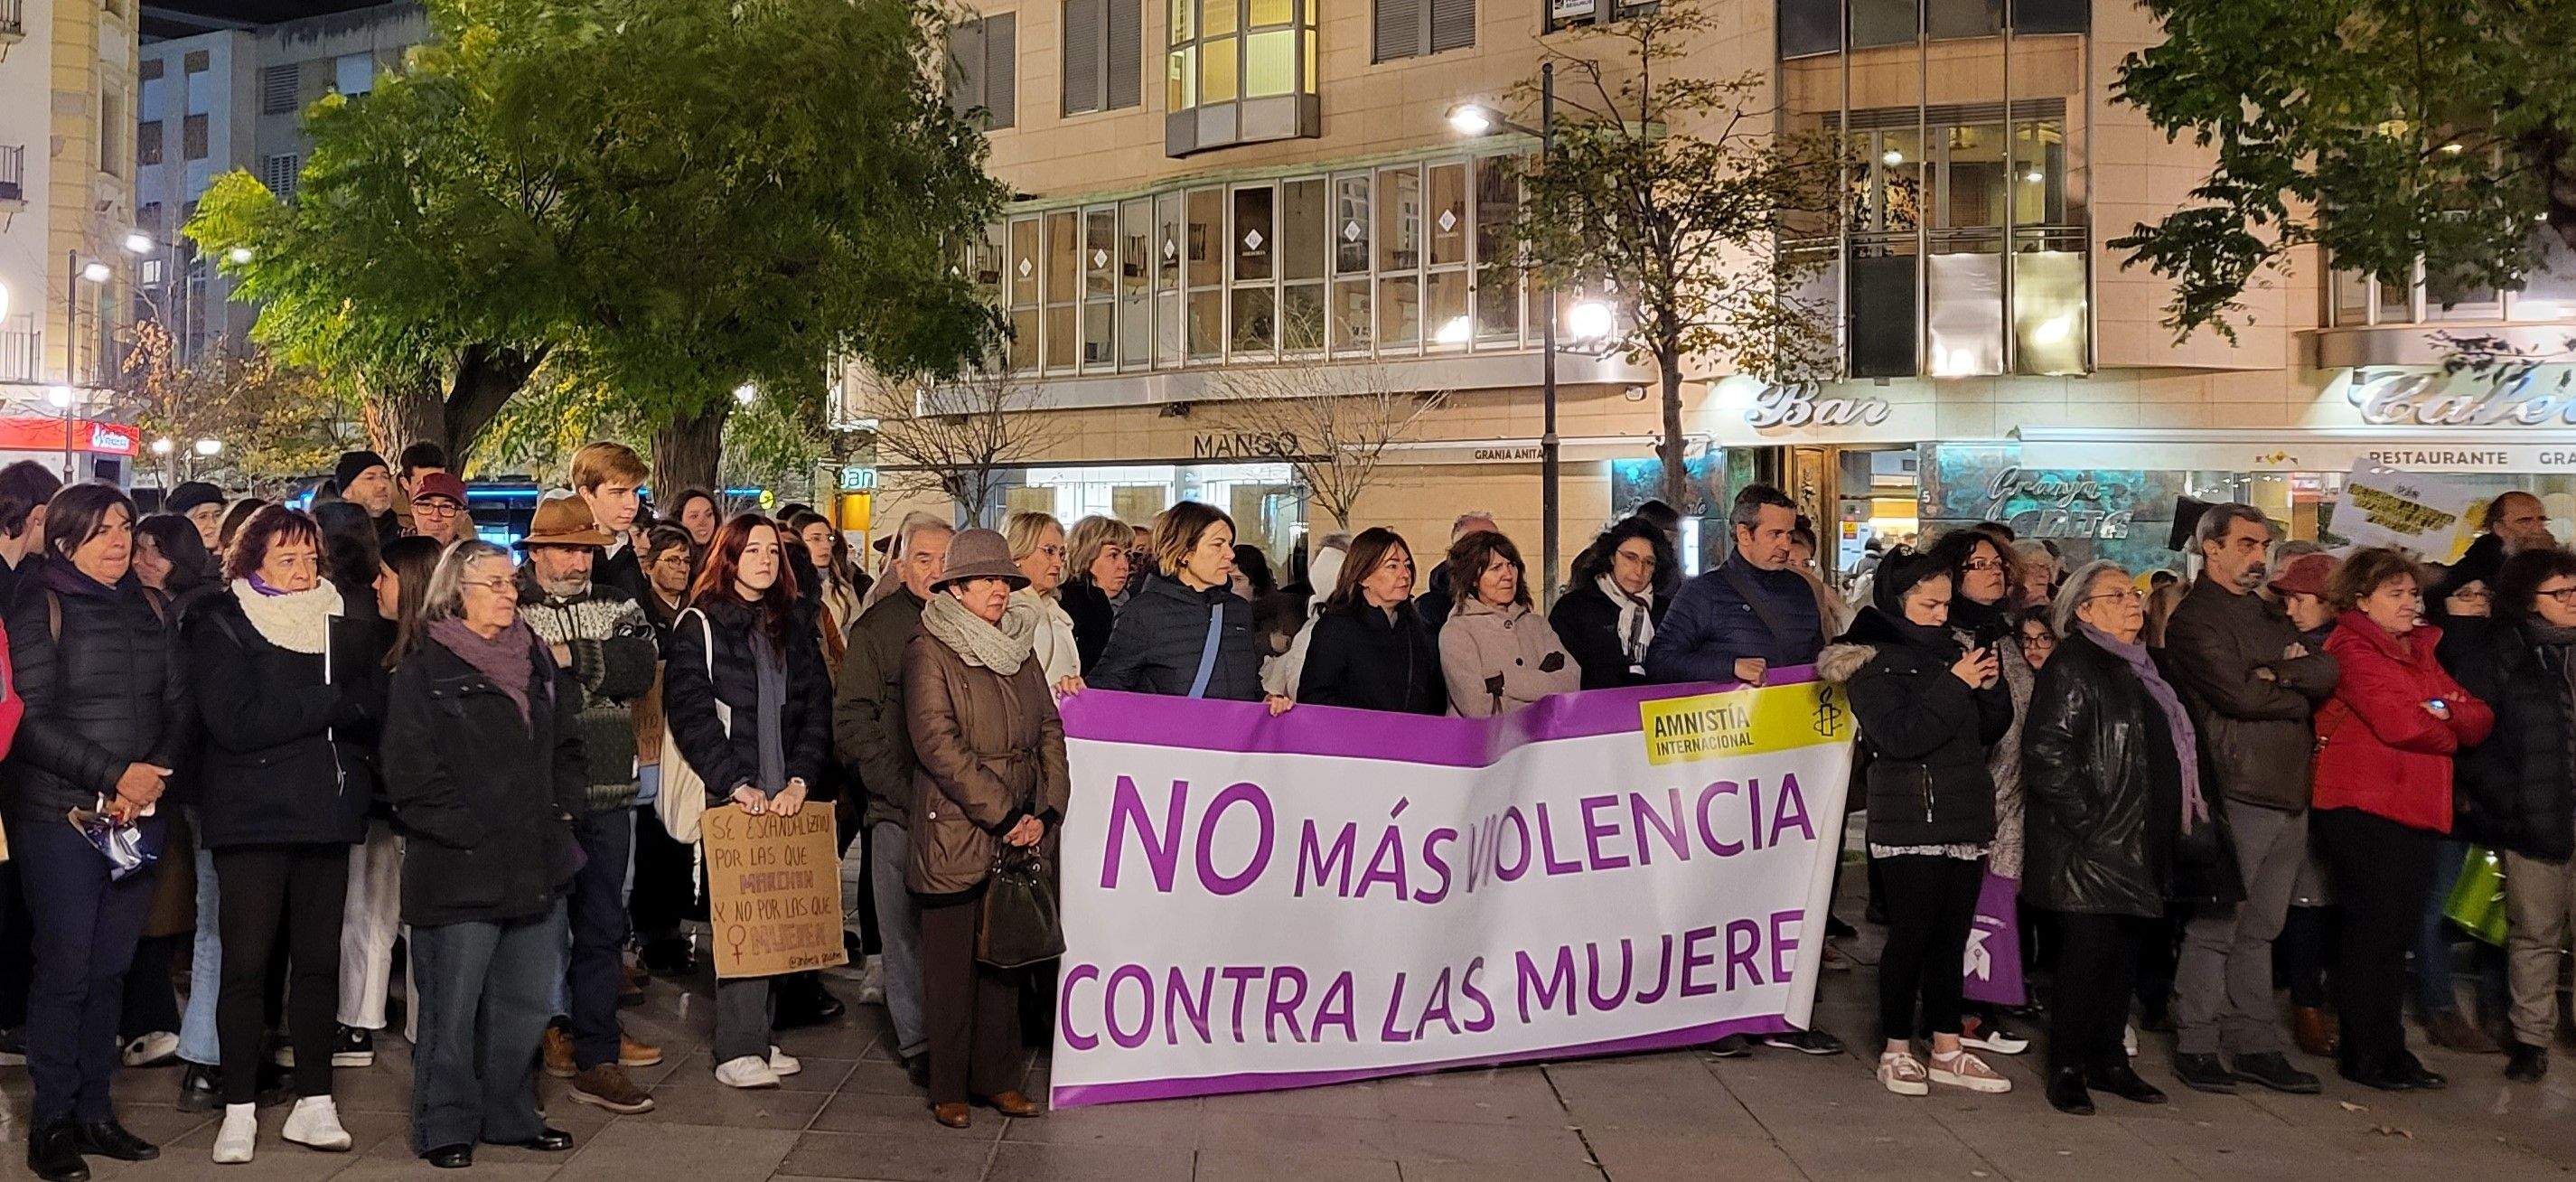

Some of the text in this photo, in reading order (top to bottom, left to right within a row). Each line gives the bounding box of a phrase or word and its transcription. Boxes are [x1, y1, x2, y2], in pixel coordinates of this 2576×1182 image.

[1745, 380, 1891, 427] Bar
[1194, 432, 1297, 459] MANGO
[1475, 448, 1544, 461] GRANJA ANITA
[2369, 451, 2508, 464] RESTAURANTE
[1922, 490, 1930, 503] 5
[1985, 465, 2102, 521] Granja
[1654, 701, 1751, 738] AMNISTÍA
[1656, 733, 1755, 756] INTERNACIONAL
[712, 815, 735, 840] SE
[1101, 773, 1817, 905] NO MÁS VIOLENCIA
[715, 845, 809, 870] POR LAS QUE
[735, 901, 753, 922] NO
[758, 898, 782, 920] POR
[786, 897, 809, 918] LAS
[811, 896, 832, 916] QUE
[1061, 963, 1357, 1051] CONTRA
[1381, 956, 1495, 1044] LAS
